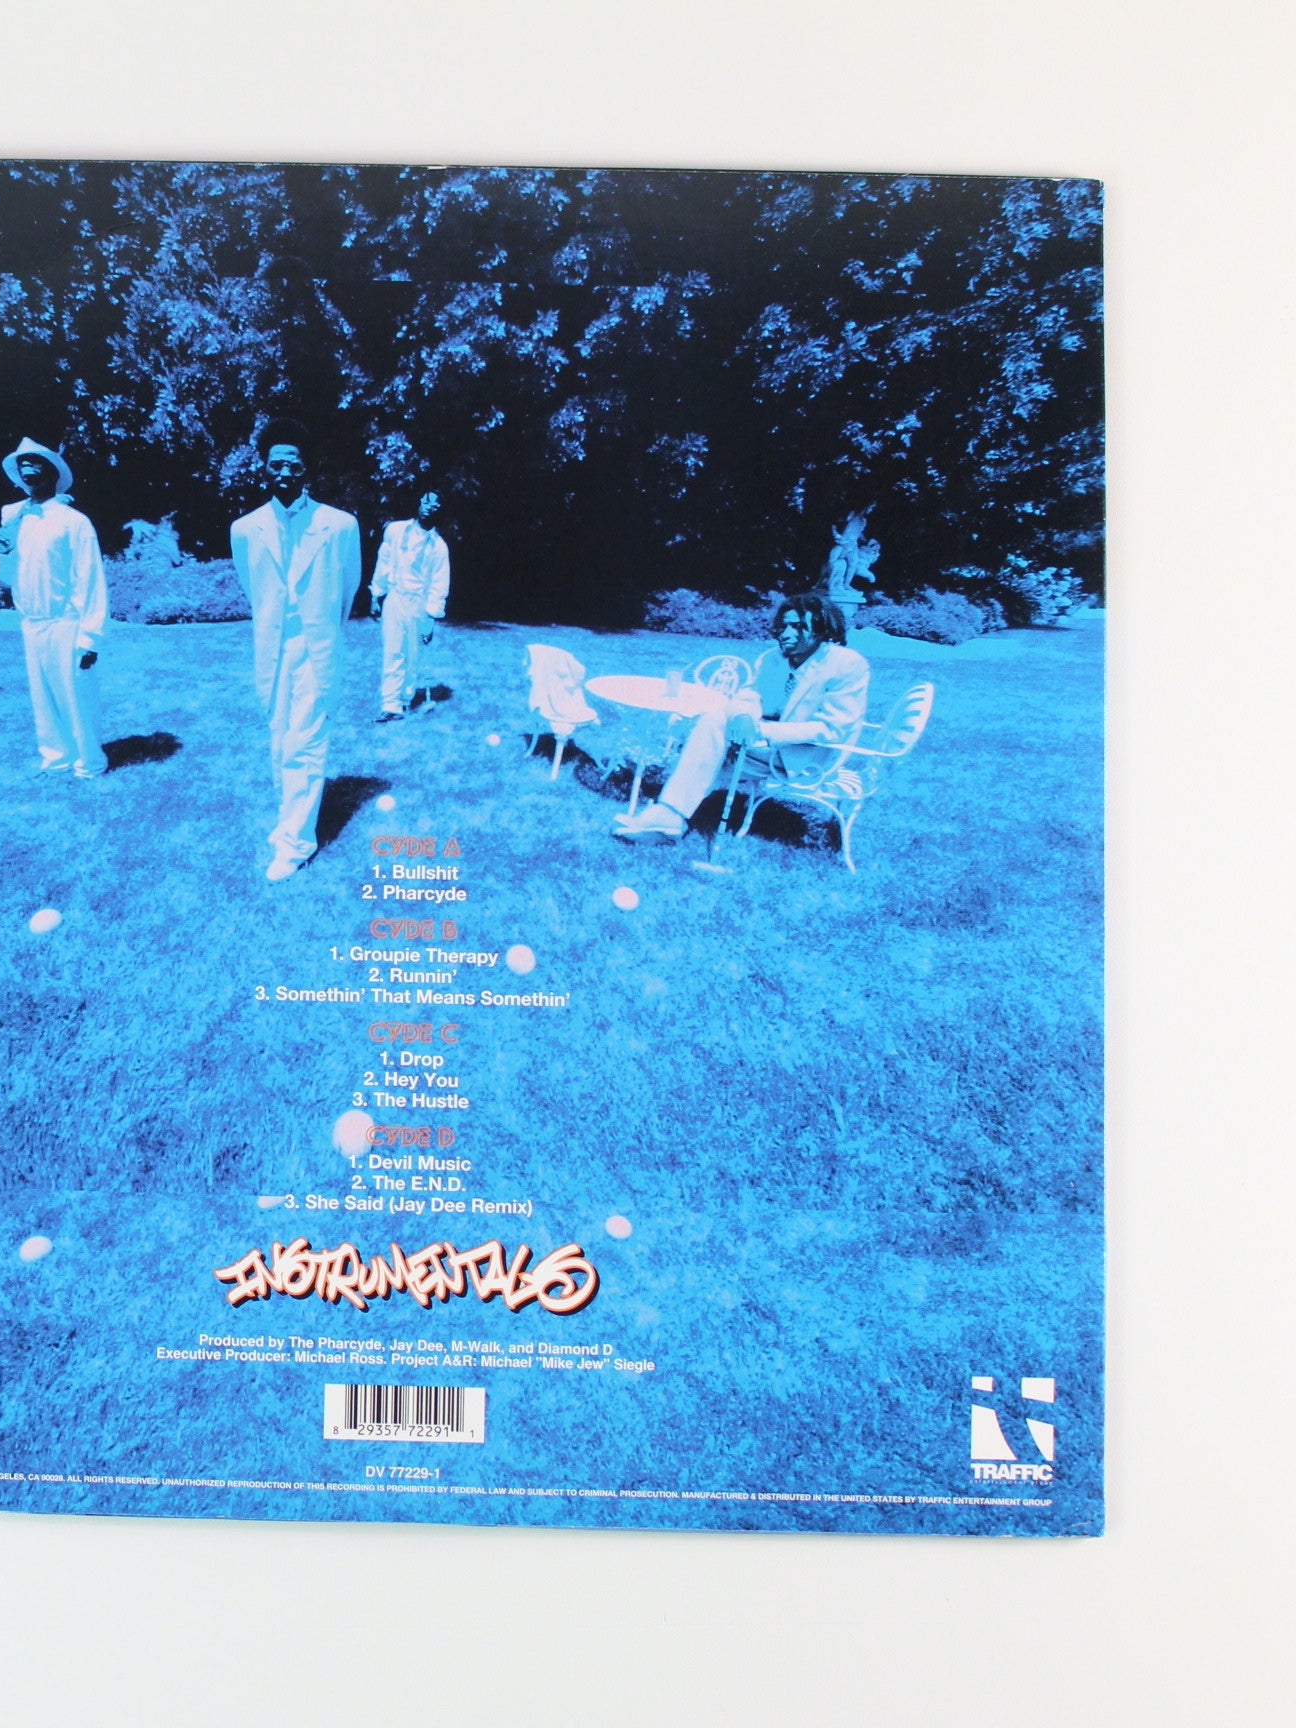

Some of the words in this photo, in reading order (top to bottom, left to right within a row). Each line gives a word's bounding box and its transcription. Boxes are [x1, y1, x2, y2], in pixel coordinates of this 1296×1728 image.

[371, 836, 437, 857] CYDE
[443, 837, 462, 857] A
[372, 865, 386, 879] 1.
[392, 865, 459, 880] Bullshit
[362, 885, 377, 899] 2.
[383, 885, 467, 903] Pharcyde
[369, 918, 435, 940] CYDE
[442, 919, 458, 940] B
[330, 947, 344, 961] 1.
[350, 946, 421, 965] Groupie
[426, 948, 498, 967] Therapy
[368, 969, 384, 982] 2.
[255, 987, 270, 1000] 3.
[371, 988, 411, 1004] That
[416, 990, 475, 1005] Means
[368, 1022, 433, 1043] CYDE
[441, 1024, 459, 1044] C
[380, 1052, 394, 1066] 1.
[400, 1052, 444, 1070] Drop
[363, 1072, 379, 1086] 2.
[385, 1072, 418, 1090] Hey
[424, 1073, 459, 1088] You
[352, 1093, 368, 1106] 3.
[374, 1093, 407, 1107] The
[412, 1094, 469, 1109] Hustle
[365, 1125, 431, 1147] CYDE
[438, 1127, 455, 1147] D
[349, 1155, 363, 1169] 1.
[369, 1155, 412, 1171] Devil
[418, 1156, 471, 1172] Music
[351, 1176, 367, 1190] 2.
[373, 1176, 405, 1191] The
[411, 1177, 466, 1192] E.N.D.
[284, 1195, 299, 1208] 3.
[305, 1195, 339, 1210] She
[344, 1196, 383, 1211] Said
[389, 1196, 425, 1216] (Jay
[430, 1198, 466, 1213] Dee
[472, 1199, 533, 1217] Remix)
[213, 1236, 601, 1317] INSTRUMENTALS
[199, 1334, 265, 1349] Produced
[268, 1335, 285, 1351] by
[289, 1336, 314, 1349] The
[318, 1337, 386, 1353] Pharcyde,
[390, 1338, 414, 1354] Jay
[417, 1339, 447, 1354] Dee,
[451, 1340, 504, 1355] M-Walk,
[508, 1342, 534, 1354] and
[538, 1342, 600, 1355] Diamond
[603, 1343, 613, 1355] D
[157, 1347, 222, 1361] Executive
[225, 1349, 291, 1363] Producer:
[295, 1351, 347, 1364] Michael
[350, 1352, 387, 1365] Ross.
[391, 1353, 438, 1369] Project
[442, 1354, 477, 1367] A&R:
[481, 1355, 531, 1368] Michael
[536, 1356, 573, 1369] "Mike
[576, 1357, 610, 1370] Jew"
[614, 1358, 655, 1373] Siegle
[332, 1425, 339, 1436] 8
[357, 1423, 402, 1436] 29357
[407, 1425, 451, 1439] 72291
[365, 1466, 385, 1477] DV
[389, 1466, 441, 1479] 77229-1
[970, 1464, 1053, 1481] TRAFFIC
[28, 1473, 40, 1482] CA
[41, 1473, 65, 1483] 90028.
[67, 1474, 82, 1483] ALL
[84, 1475, 114, 1484] RIGHTS
[116, 1476, 160, 1486] RESERVED.
[162, 1477, 225, 1488] UNAUTHORIZED
[228, 1479, 292, 1490] REPRODUCTION
[306, 1482, 324, 1491] THIS
[327, 1482, 375, 1492] RECORDING
[387, 1484, 436, 1494] PROHIBITED
[450, 1486, 486, 1495] FEDERAL
[488, 1487, 506, 1496] LAW
[508, 1487, 525, 1496] AND
[528, 1487, 564, 1497] SUBJECT
[578, 1488, 618, 1498] CRIMINAL
[620, 1489, 680, 1499] PROSECUTION.
[682, 1491, 748, 1501] MANUFACTURED
[758, 1492, 811, 1502] DISTRIBUTED
[823, 1493, 839, 1503] THE
[841, 1494, 870, 1503] UNITED
[872, 1494, 904, 1504] STATES
[918, 1495, 952, 1505] TRAFFIC
[953, 1496, 1020, 1506] ENTERTAINMENT
[1022, 1498, 1052, 1507] GROUP
